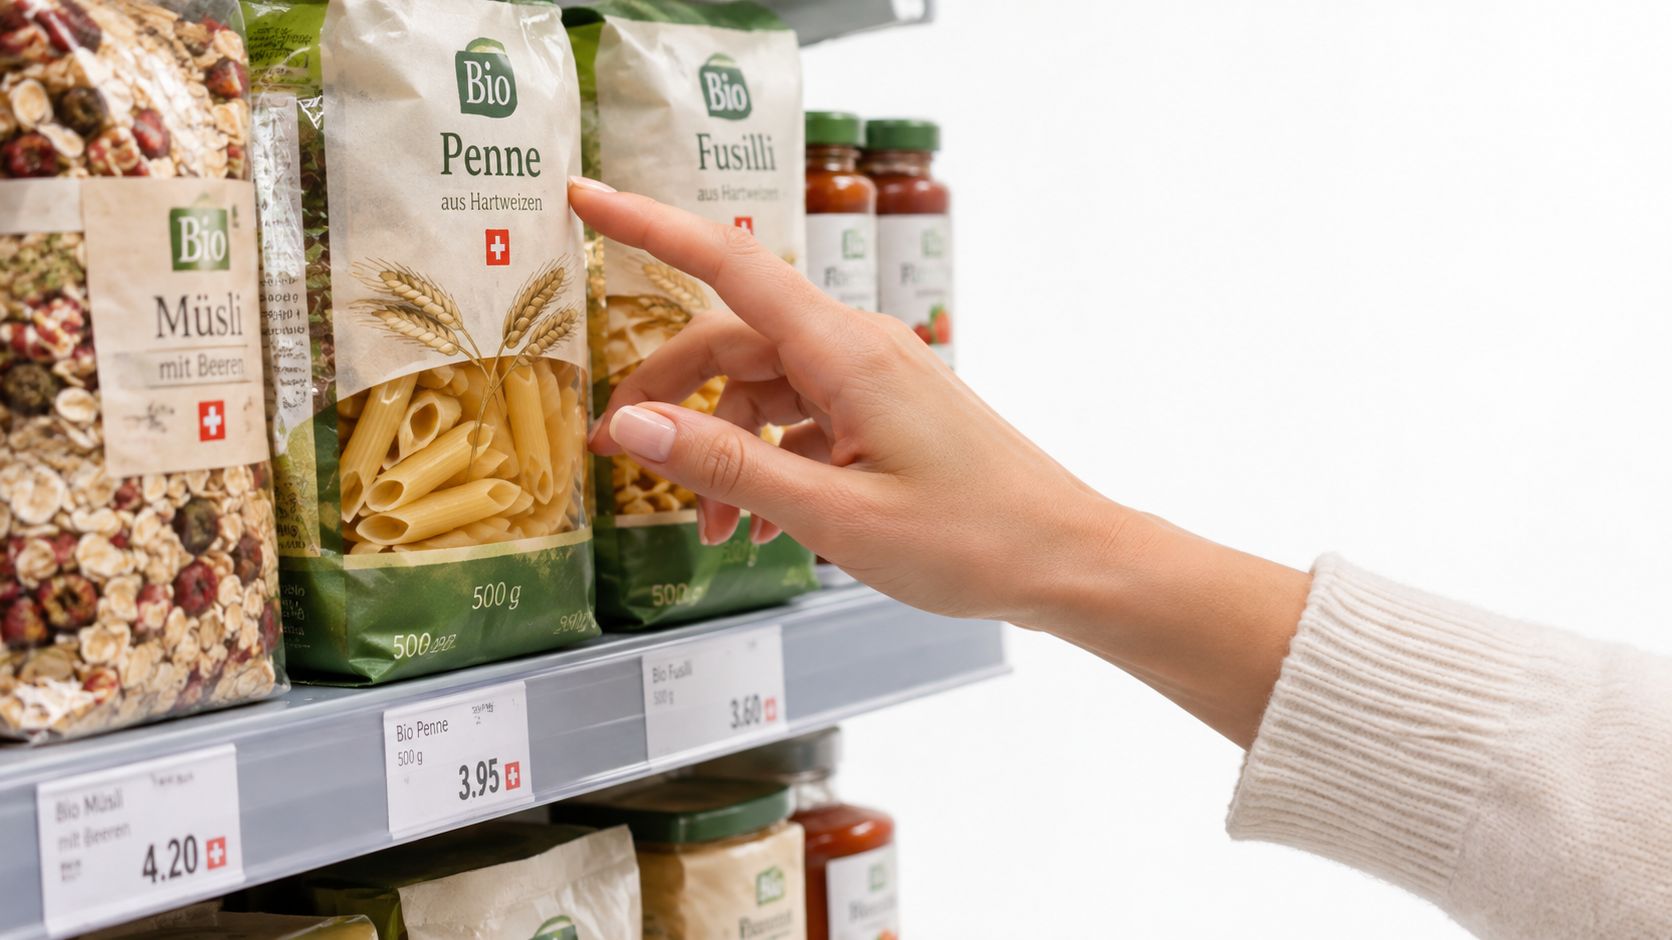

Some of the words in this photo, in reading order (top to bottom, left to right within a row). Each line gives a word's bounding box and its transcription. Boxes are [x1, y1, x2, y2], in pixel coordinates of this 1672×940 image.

[463, 60, 511, 106] Bio
[703, 71, 748, 112] Bio
[440, 132, 542, 178] Penne
[696, 133, 777, 171] Fusilli
[441, 195, 466, 211] aus
[470, 192, 543, 211] Hartweizen
[697, 188, 719, 201] aus
[178, 215, 227, 263] Bio
[153, 292, 243, 338] Müsli
[159, 356, 192, 380] mit
[197, 353, 244, 378] Beeren
[472, 581, 507, 610] 500
[509, 585, 522, 610] g
[730, 693, 761, 729] 3.60
[396, 723, 414, 742] Bio
[417, 719, 449, 739] Penne
[398, 749, 415, 767] 500
[417, 750, 423, 766] g
[458, 758, 500, 801] 3.95
[55, 800, 80, 823] Bio
[142, 834, 199, 884] 4.20
